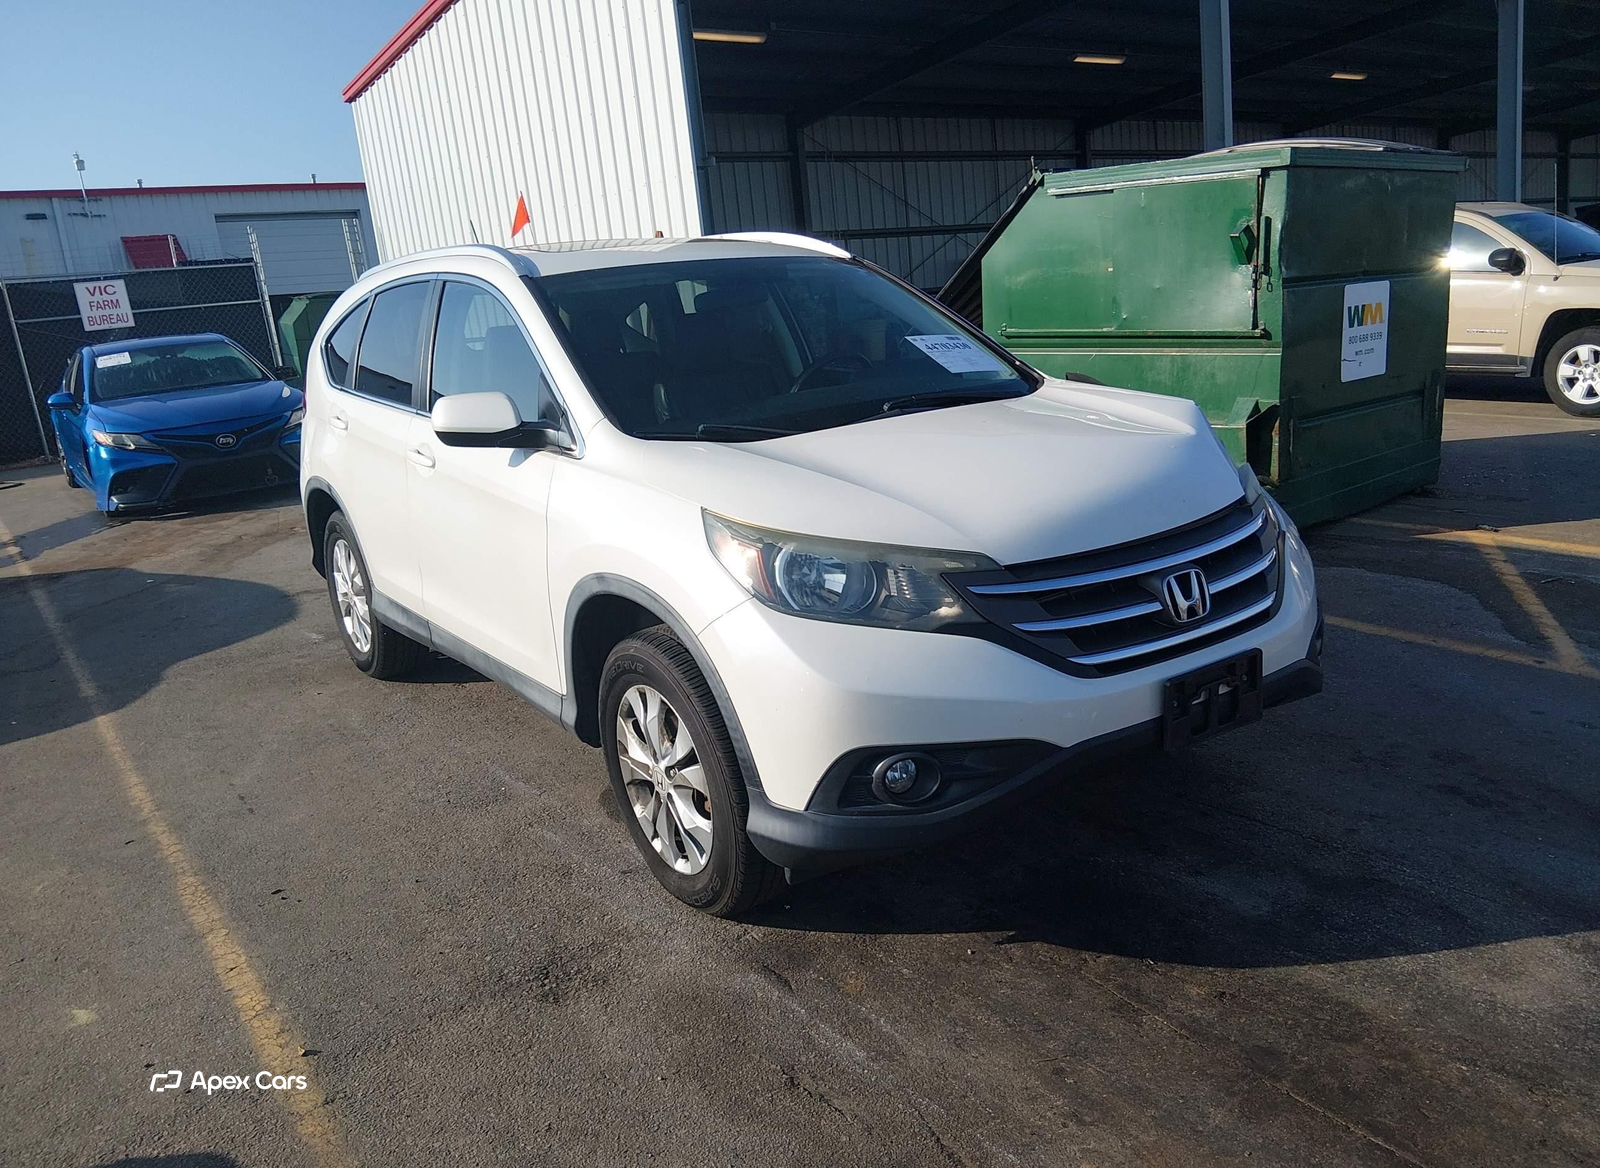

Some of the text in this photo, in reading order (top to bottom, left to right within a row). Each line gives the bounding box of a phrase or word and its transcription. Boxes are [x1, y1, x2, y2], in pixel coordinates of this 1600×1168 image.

[85, 284, 117, 297] VIC
[88, 299, 121, 312] FARM
[87, 313, 129, 327] BUREAU
[1347, 302, 1384, 329] WM
[1348, 335, 1359, 345] 800
